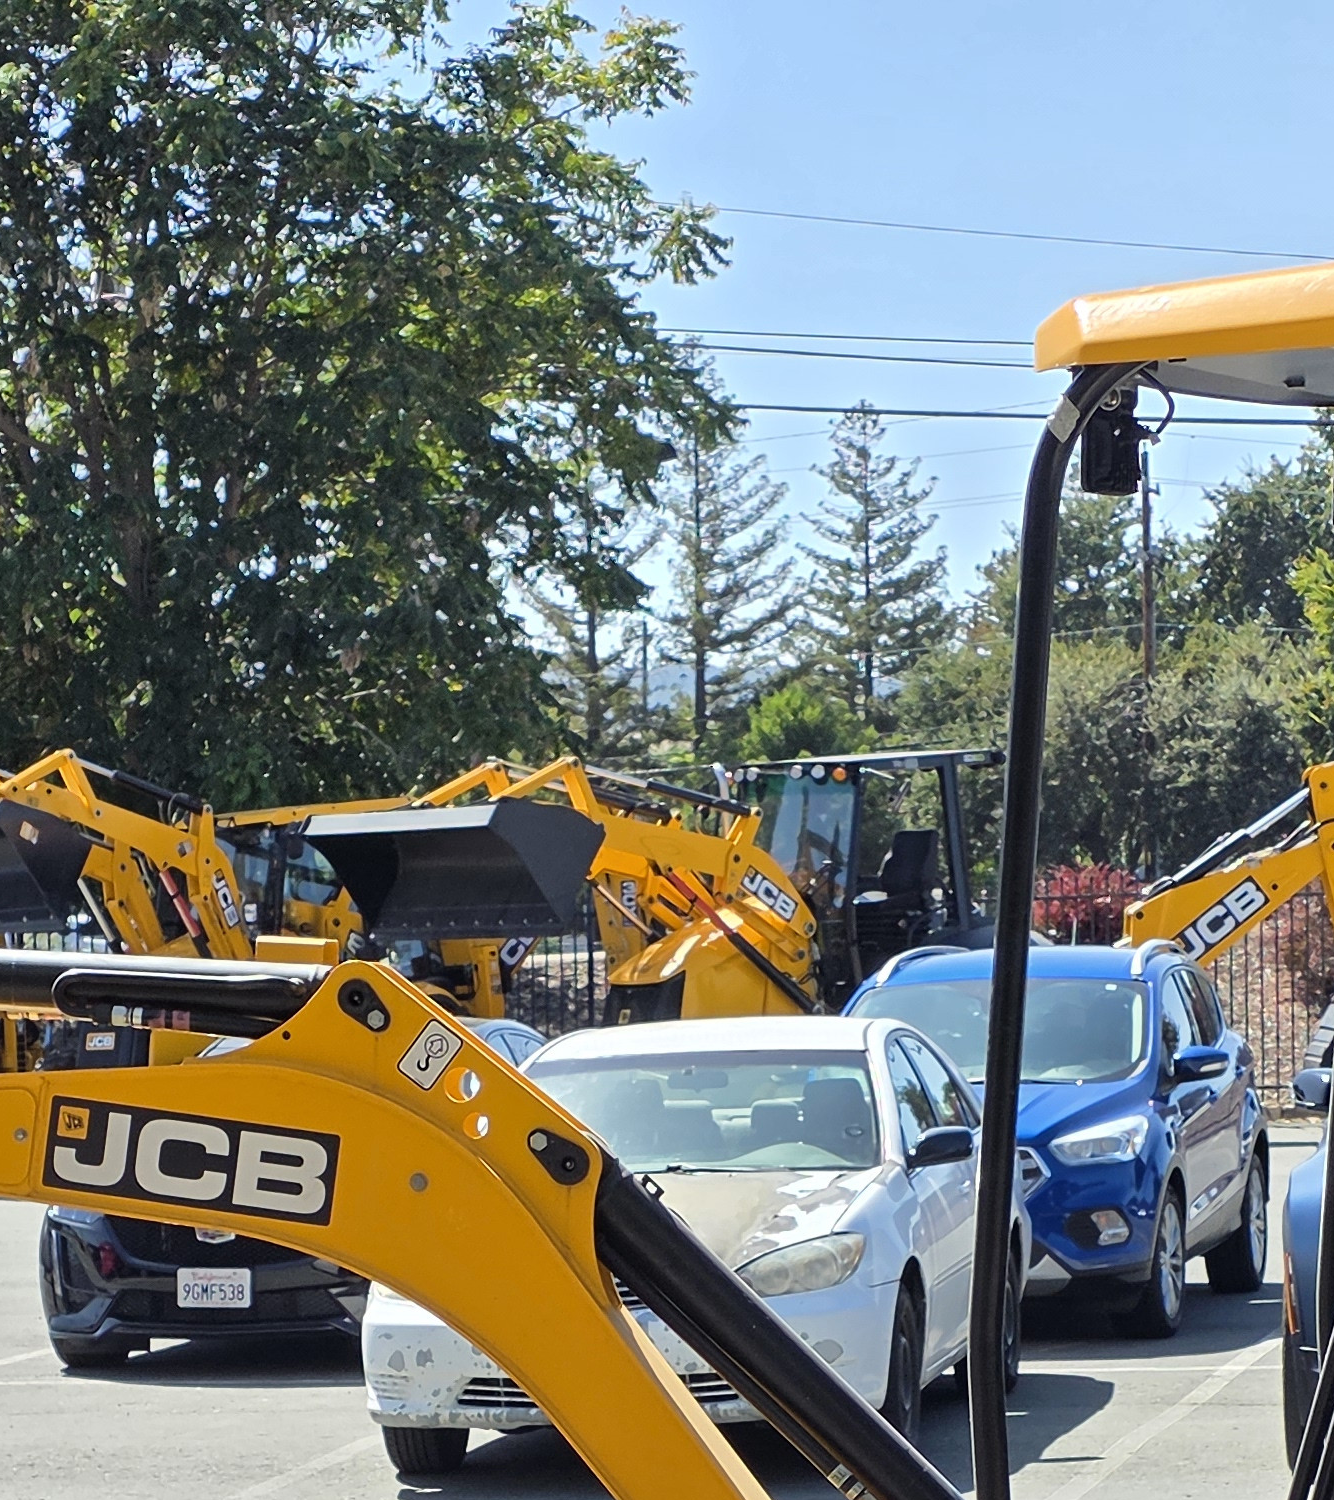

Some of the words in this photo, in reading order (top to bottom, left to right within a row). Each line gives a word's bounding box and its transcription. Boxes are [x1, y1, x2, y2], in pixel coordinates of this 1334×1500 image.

[743, 874, 796, 919] JCB
[1185, 881, 1266, 960] JCB
[53, 1112, 328, 1214] JCB
[183, 1283, 245, 1301] 9GMF538
